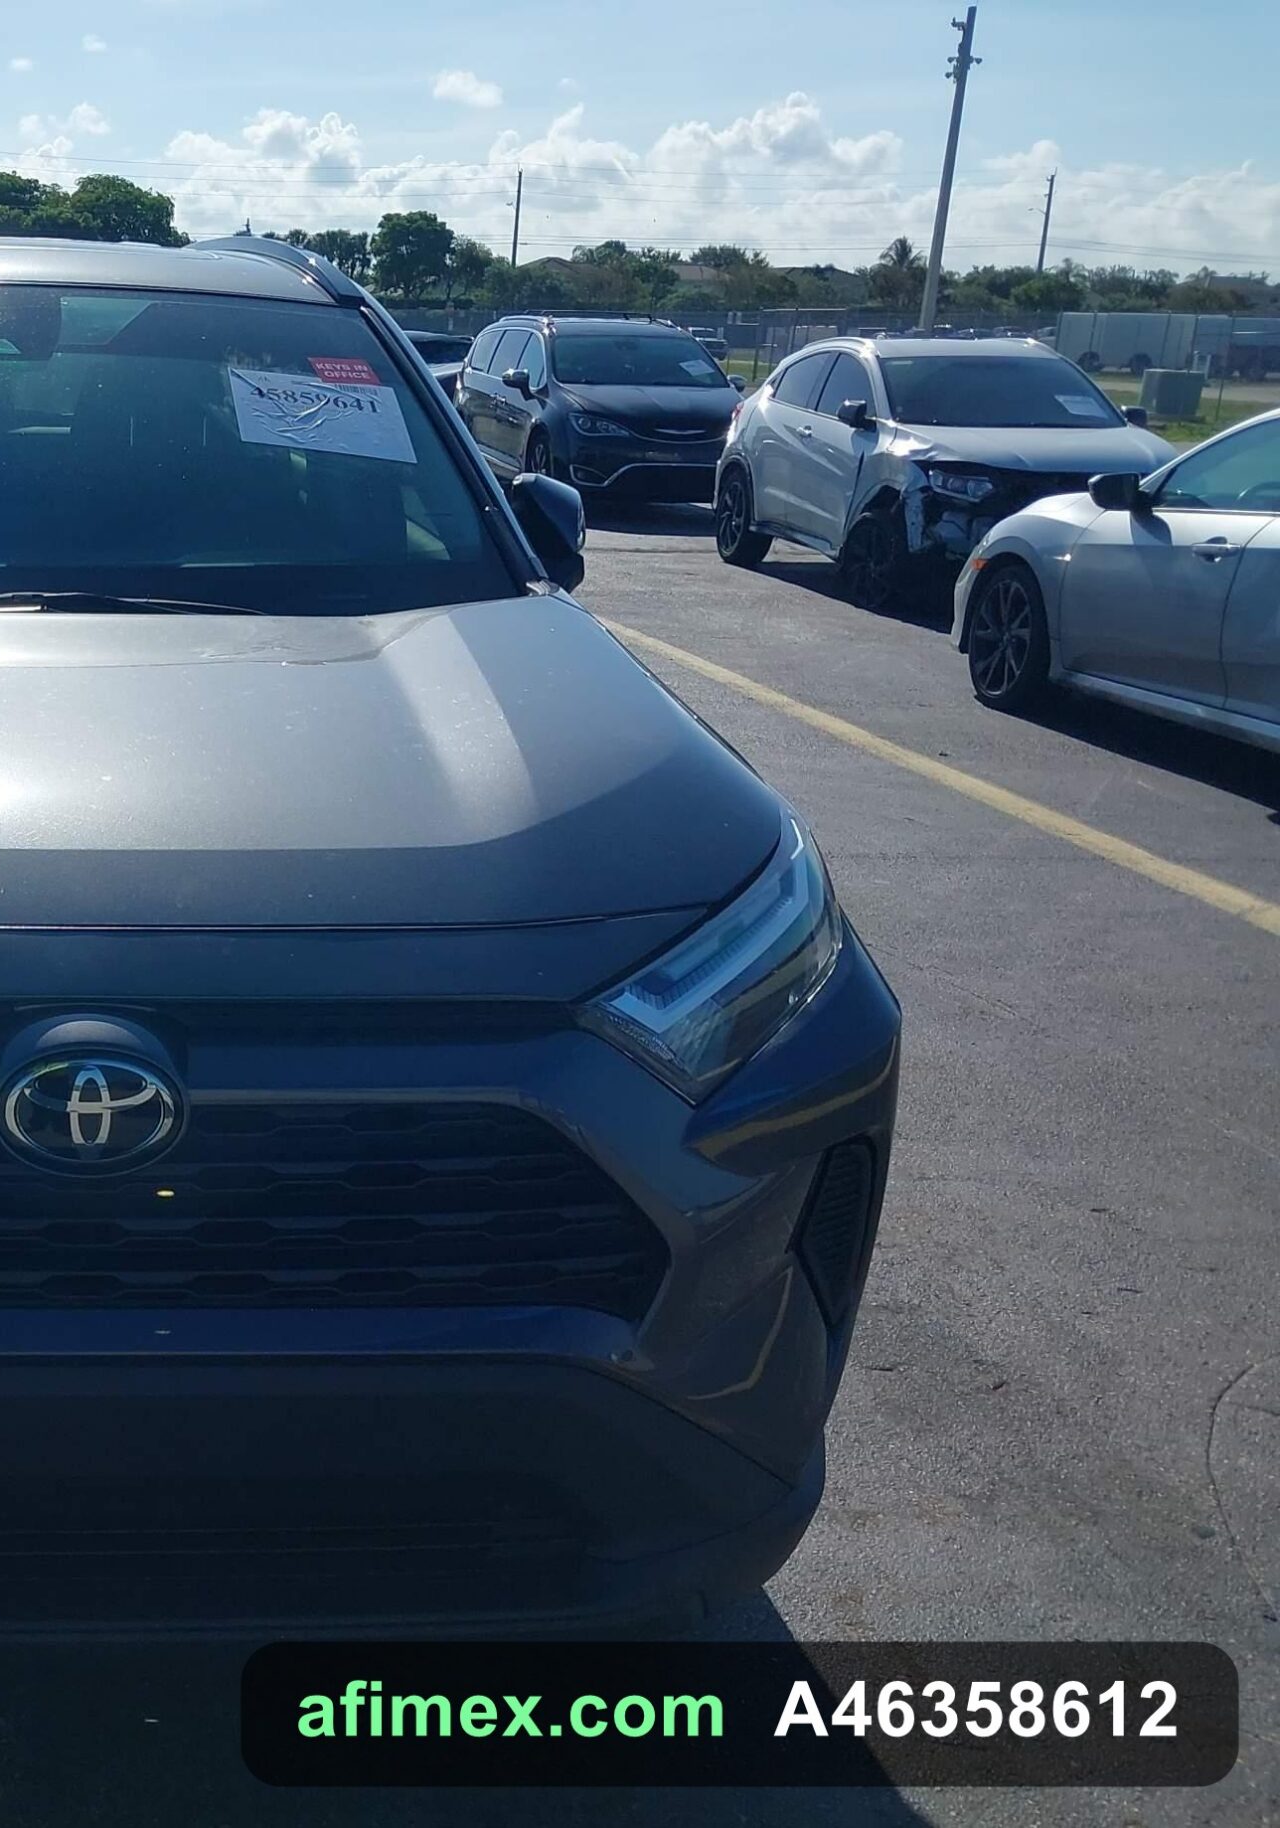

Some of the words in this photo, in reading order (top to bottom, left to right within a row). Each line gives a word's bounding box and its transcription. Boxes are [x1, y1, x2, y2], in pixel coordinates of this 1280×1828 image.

[315, 363, 351, 371] KEYS
[353, 364, 369, 372] IN
[324, 370, 371, 380] OFFICE
